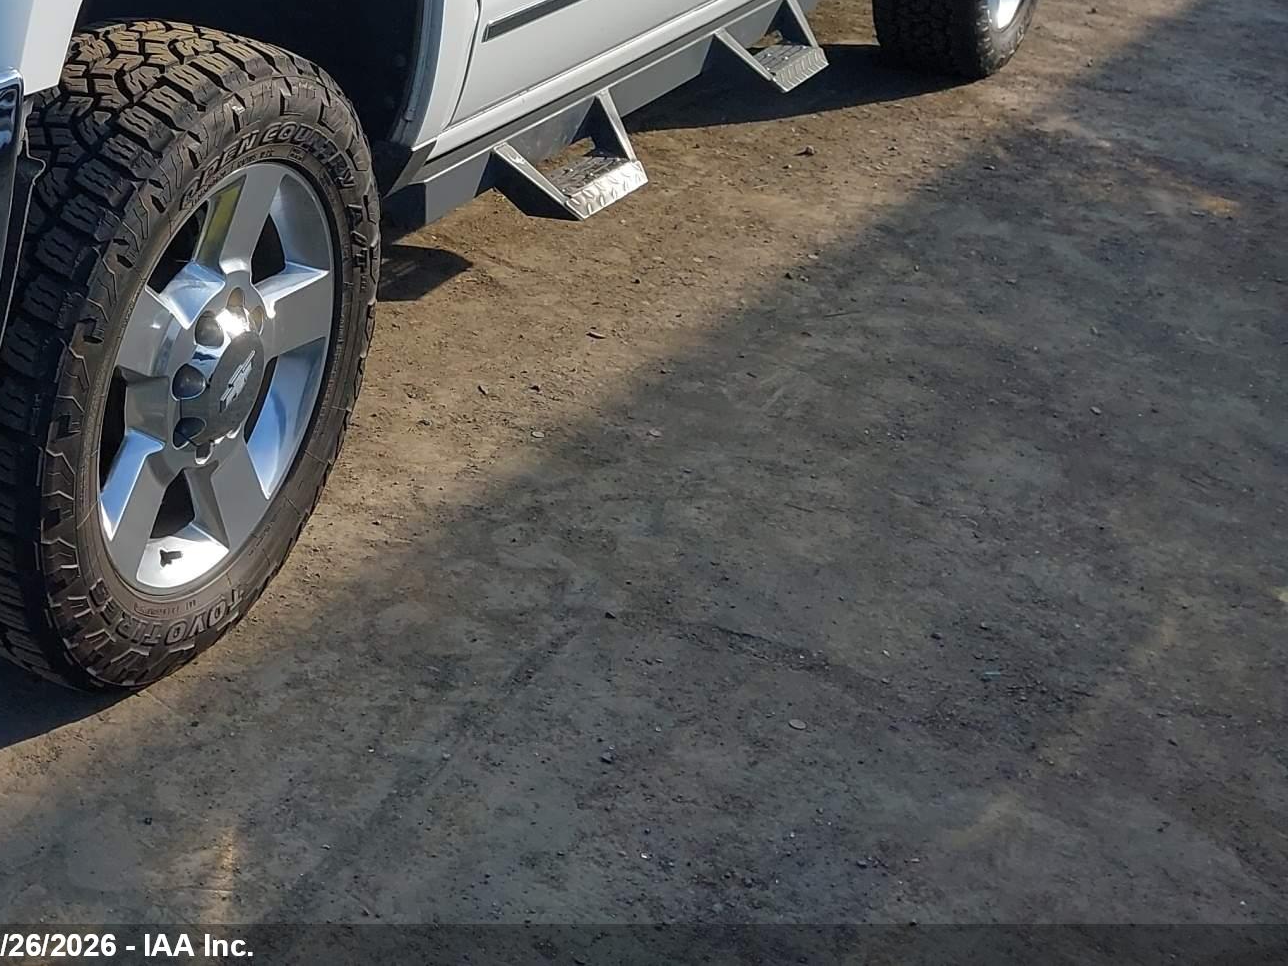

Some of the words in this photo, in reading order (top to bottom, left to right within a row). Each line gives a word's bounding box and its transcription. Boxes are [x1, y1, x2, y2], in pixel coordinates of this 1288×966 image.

[179, 129, 260, 210] OPEN
[259, 120, 357, 189] COUNTRY
[87, 577, 164, 645] TIRES
[164, 587, 246, 646] TOYO
